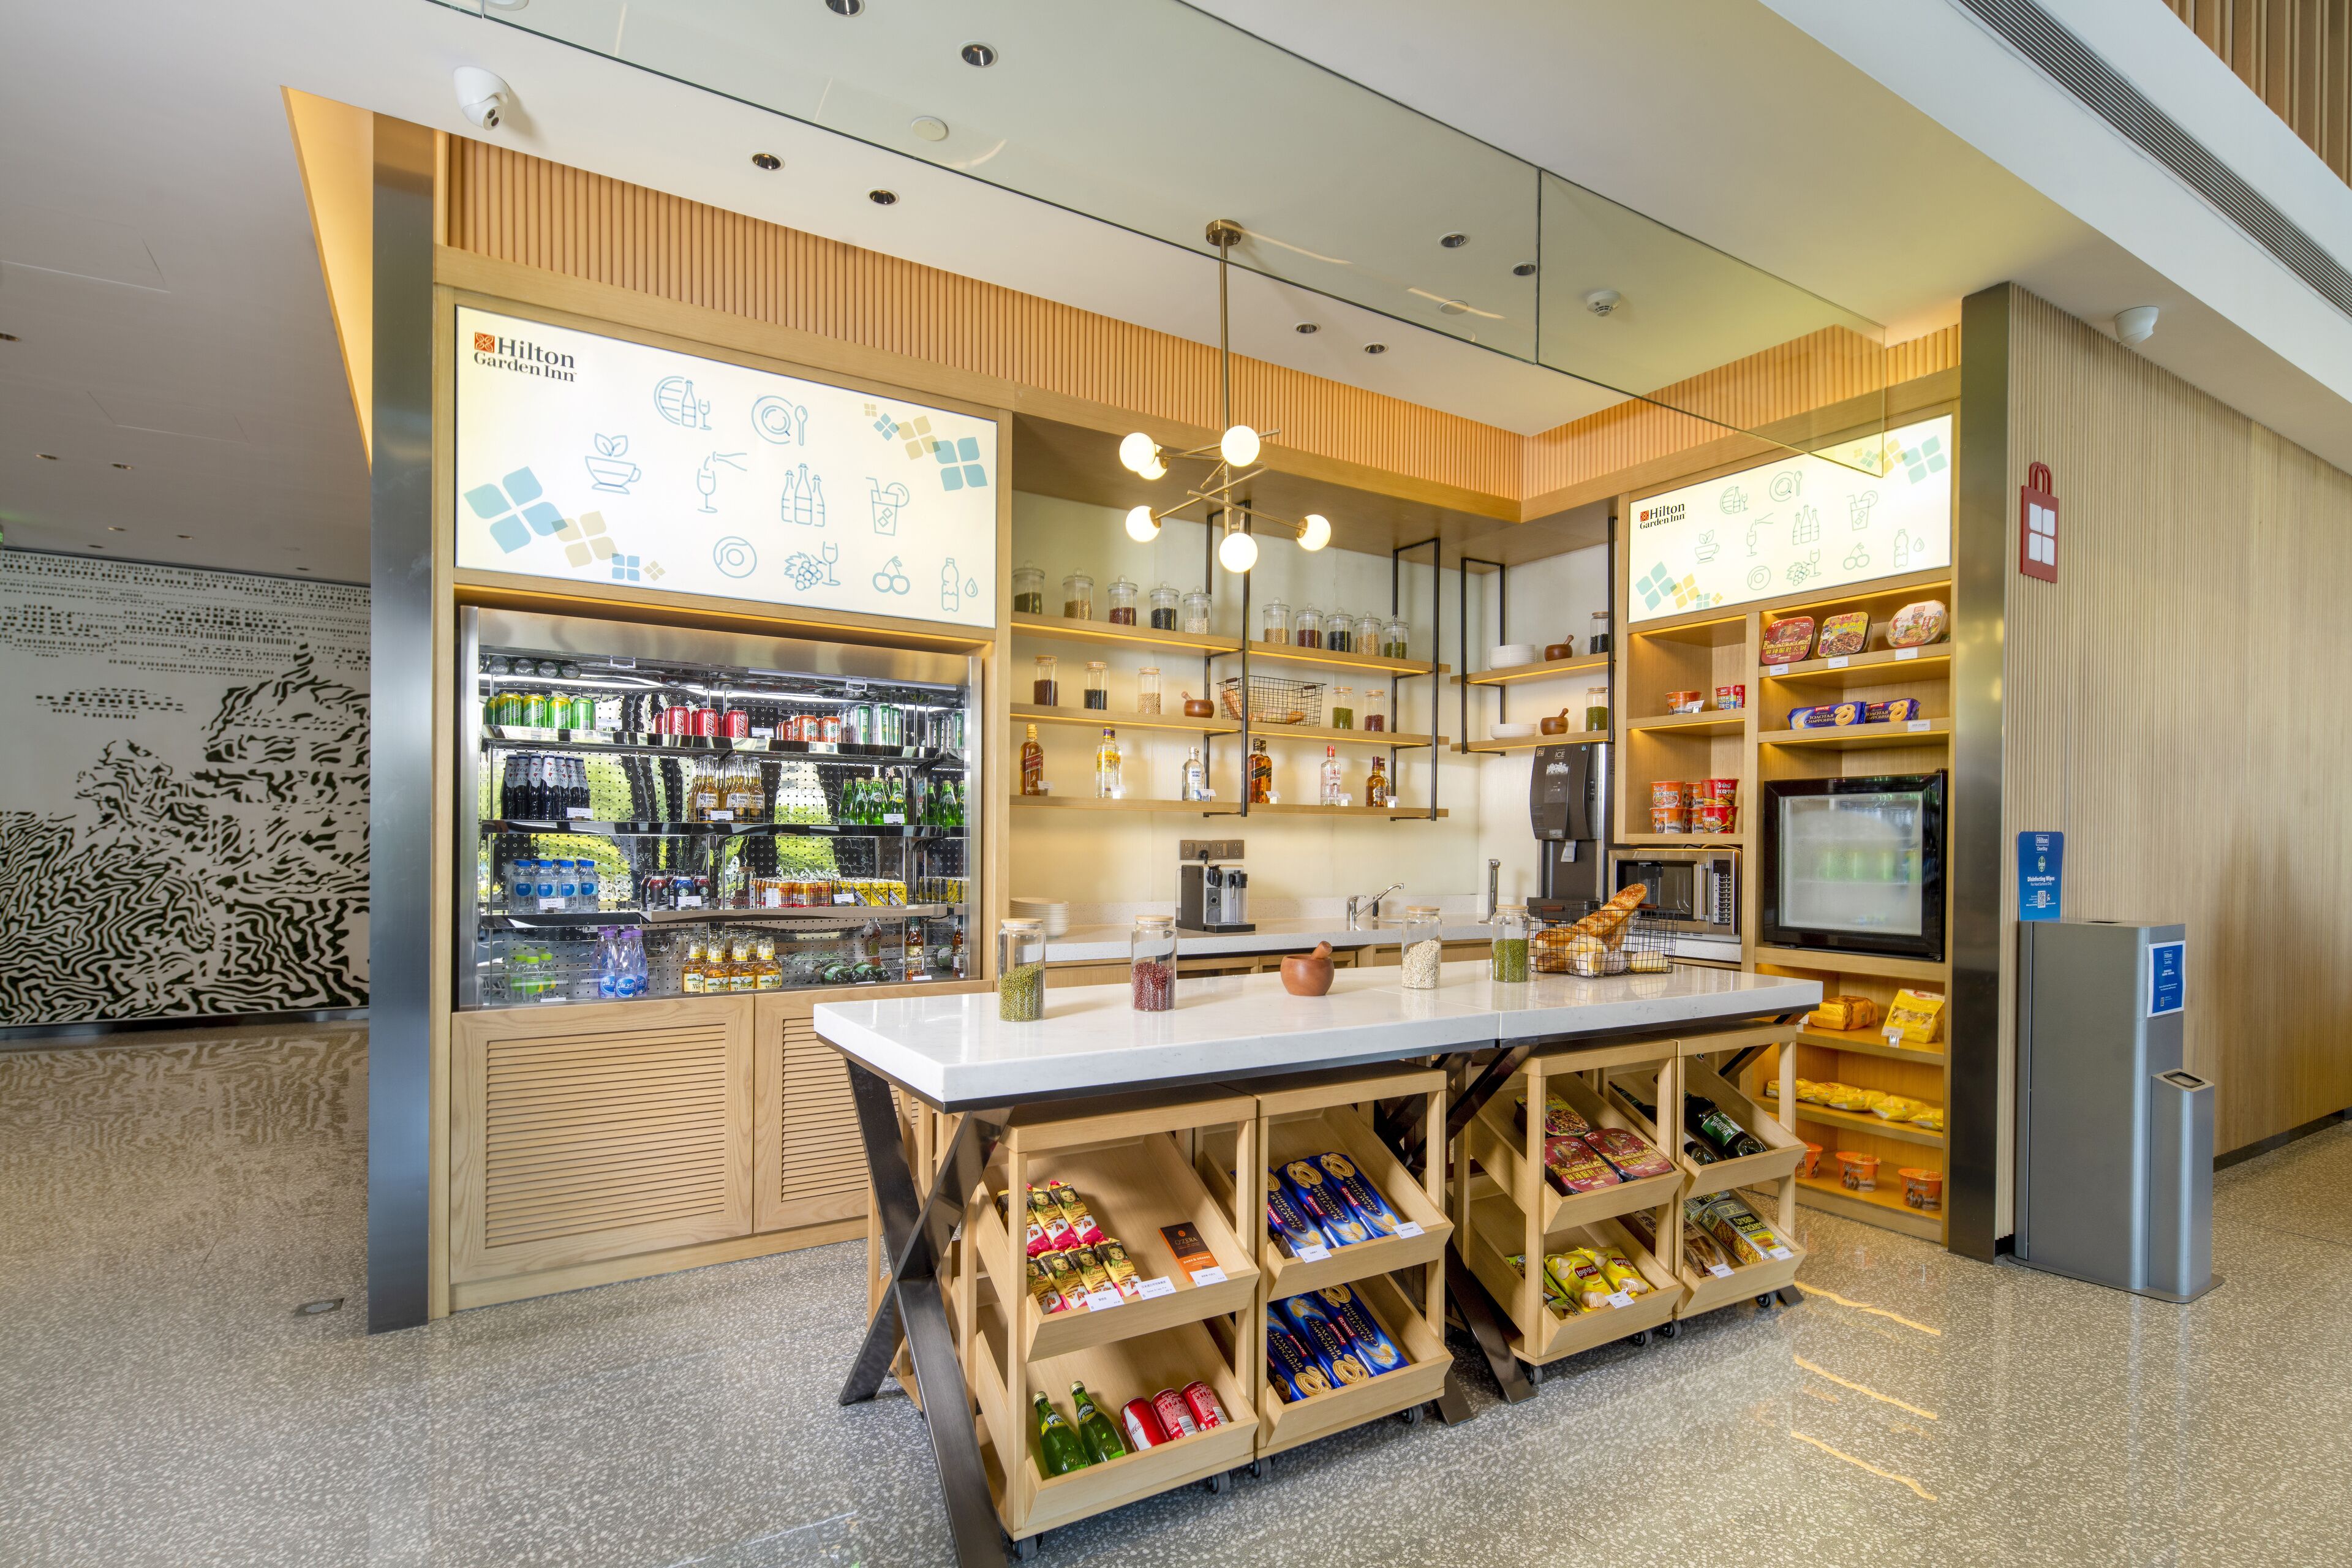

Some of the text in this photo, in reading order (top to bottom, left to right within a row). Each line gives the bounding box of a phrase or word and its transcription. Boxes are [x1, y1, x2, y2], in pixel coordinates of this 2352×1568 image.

[474, 351, 575, 382] Garden Inn
[497, 336, 575, 369] Hilton
[1640, 513, 1685, 530] Garden Inn
[1650, 503, 1685, 519] Hilton
[1711, 1120, 1728, 1136] БЕЛЫЙ
[1713, 1115, 1735, 1135] МЕДВЕДЬ
[1270, 1195, 1298, 1229] ЗОЛОТАЯ
[1275, 1191, 1307, 1233] СИМФОНИЯ
[1313, 1188, 1338, 1220] ЗОЛОТАЯ
[1317, 1185, 1349, 1223] СИМФОНИЯ
[1346, 1180, 1373, 1212] ЗОЛОТАЯ
[1349, 1177, 1382, 1216] СИМФОНИЯ
[1268, 1204, 1283, 1224] КУХМАСТ
[1733, 1215, 1755, 1224] Cream
[1737, 1221, 1766, 1234] Crackers
[1577, 1268, 1588, 1278] Lay's
[1305, 1316, 1339, 1360] СИМФОНИЯ
[1315, 1319, 1342, 1355] ЗОЛОТАЯ
[1342, 1306, 1370, 1343] ЗОЛОТАЯ
[1346, 1303, 1379, 1346] СИМФОНИЯ
[1273, 1332, 1303, 1368] ЗОЛОТАЯ
[1170, 1425, 1180, 1435] Coke
